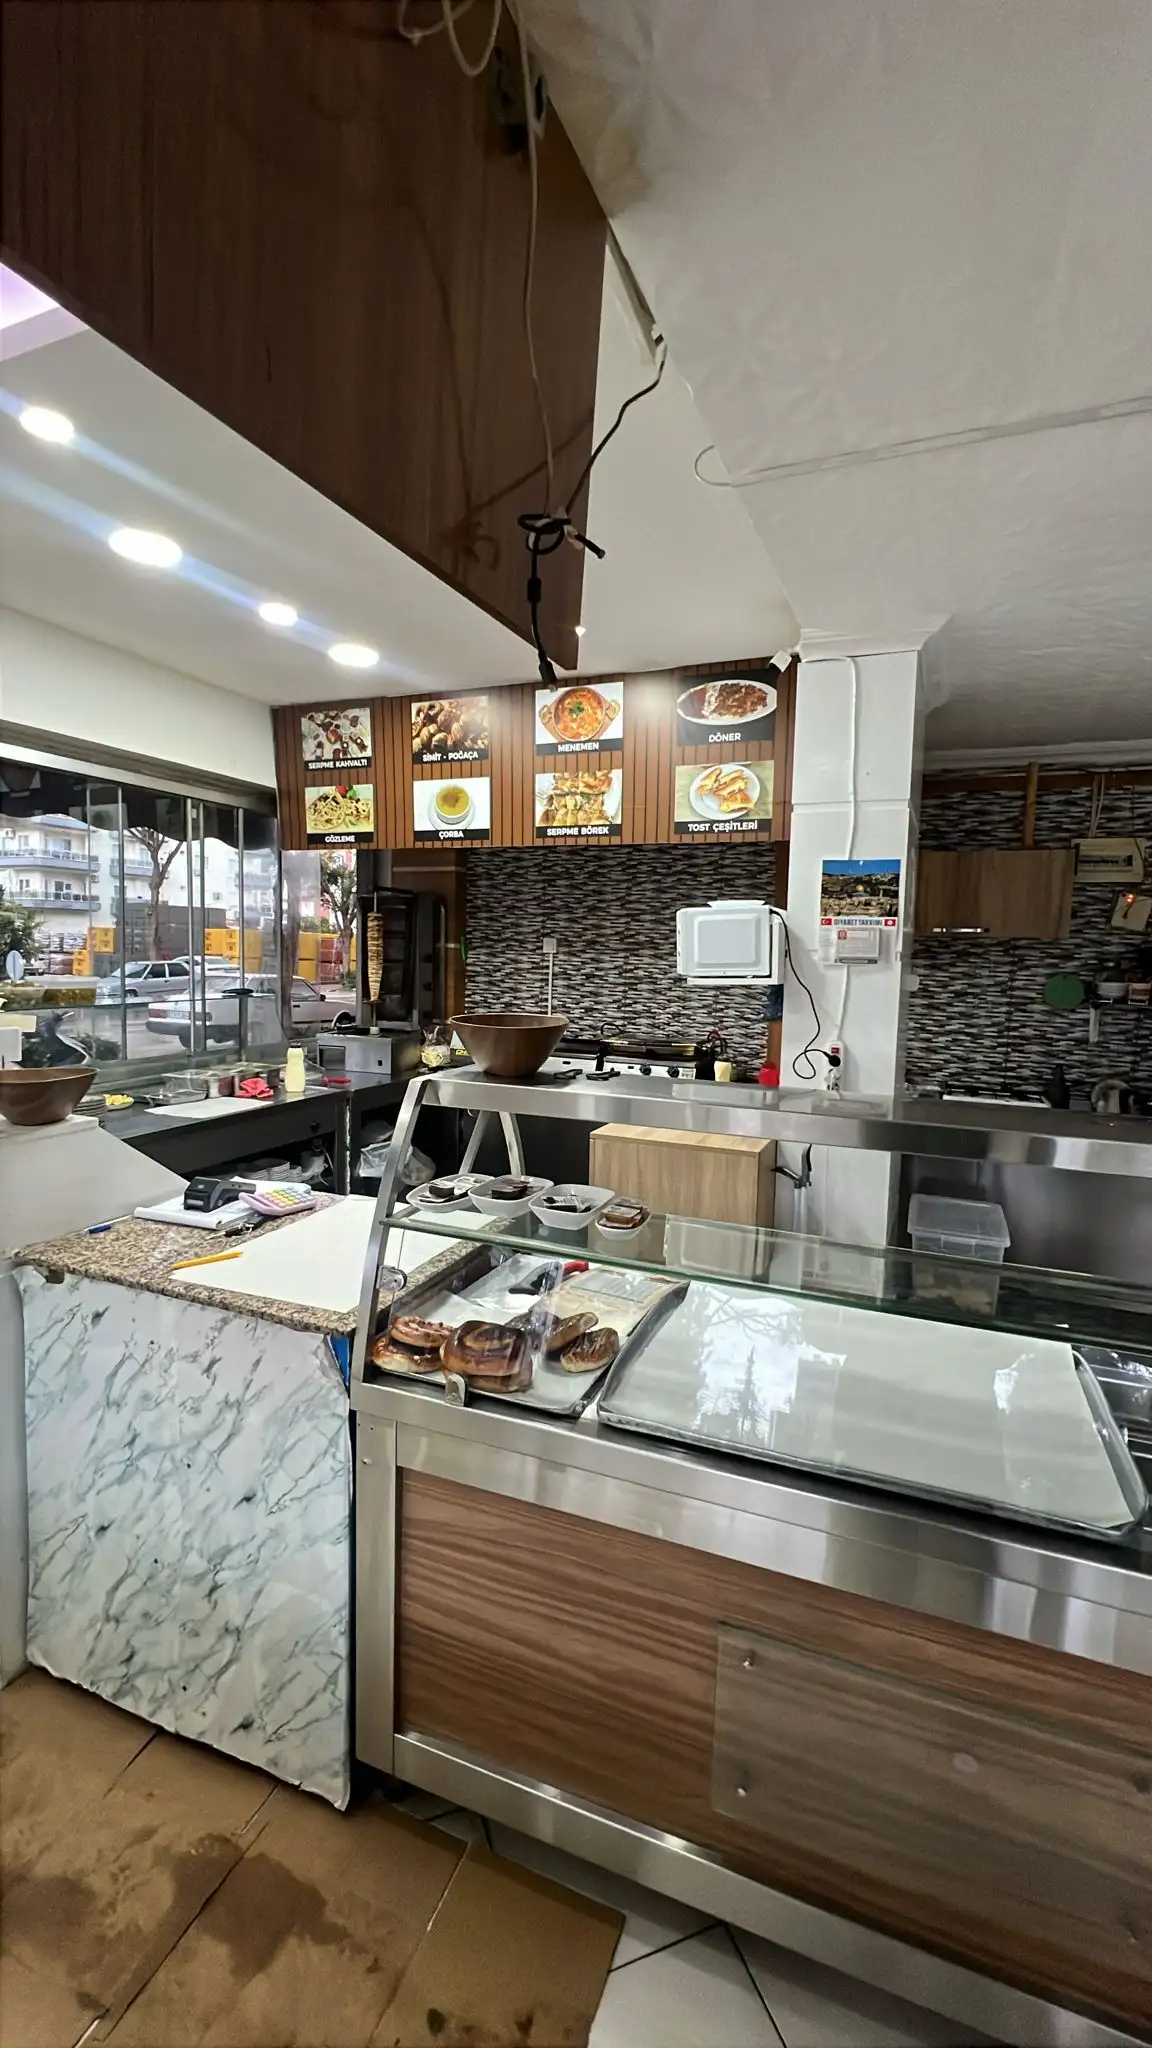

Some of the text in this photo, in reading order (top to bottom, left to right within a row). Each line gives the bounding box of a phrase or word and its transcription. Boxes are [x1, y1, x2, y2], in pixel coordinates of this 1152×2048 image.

[708, 733, 741, 743] DÖNER
[558, 742, 599, 753] MENEMEN
[423, 753, 441, 762] SİMİT
[449, 751, 477, 761] POĞAÇA
[308, 759, 367, 769] SERPME KAHVALTI
[546, 826, 609, 836] SERPME BÖREK
[687, 821, 757, 833] TOST ÇEŞİTLERİ
[325, 835, 355, 843] GÖZLEME
[439, 830, 463, 840] ÇORBA
